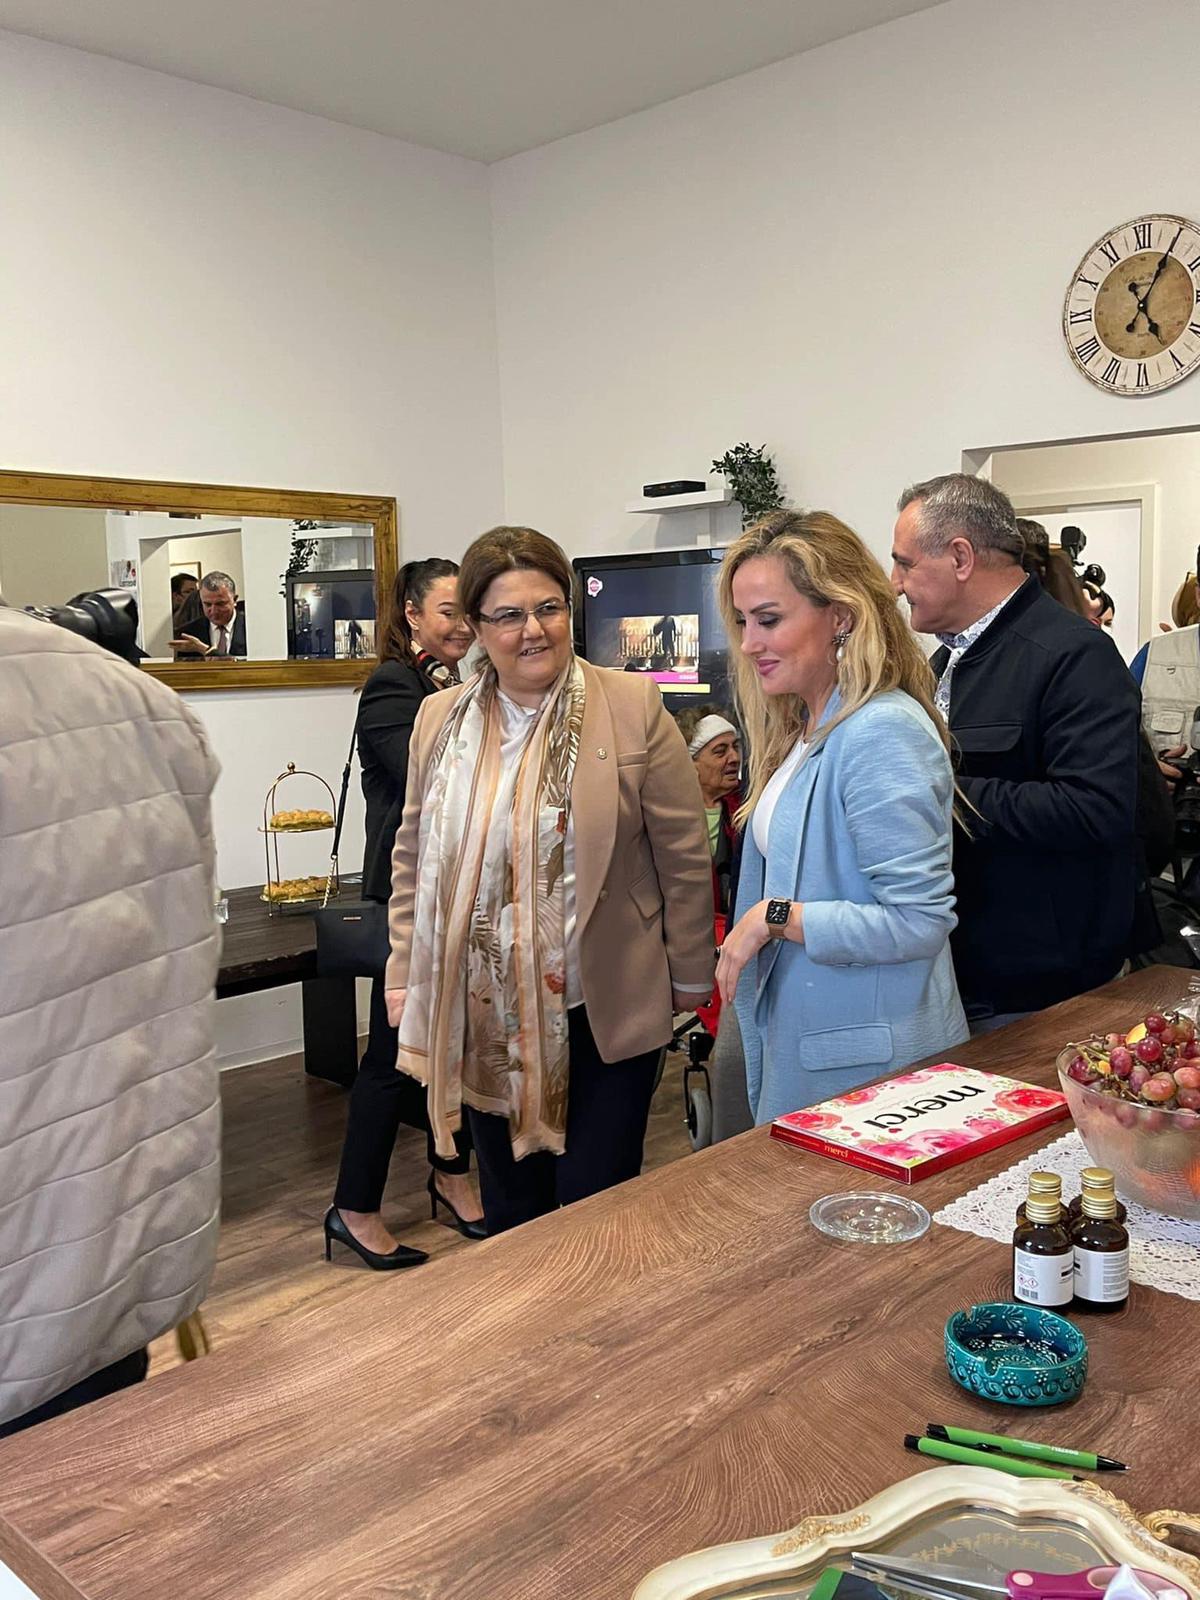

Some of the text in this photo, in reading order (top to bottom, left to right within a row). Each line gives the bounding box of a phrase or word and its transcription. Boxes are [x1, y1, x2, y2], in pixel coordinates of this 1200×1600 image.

[1132, 222, 1153, 252] XII
[1098, 239, 1120, 268] XI
[1076, 273, 1100, 291] X
[1070, 308, 1092, 325] IX
[1075, 335, 1101, 366] VIII
[1168, 348, 1185, 371] V
[1101, 356, 1121, 385] VII
[1136, 362, 1149, 387] VI
[863, 1085, 986, 1133] merci
[824, 1143, 849, 1158] merci
